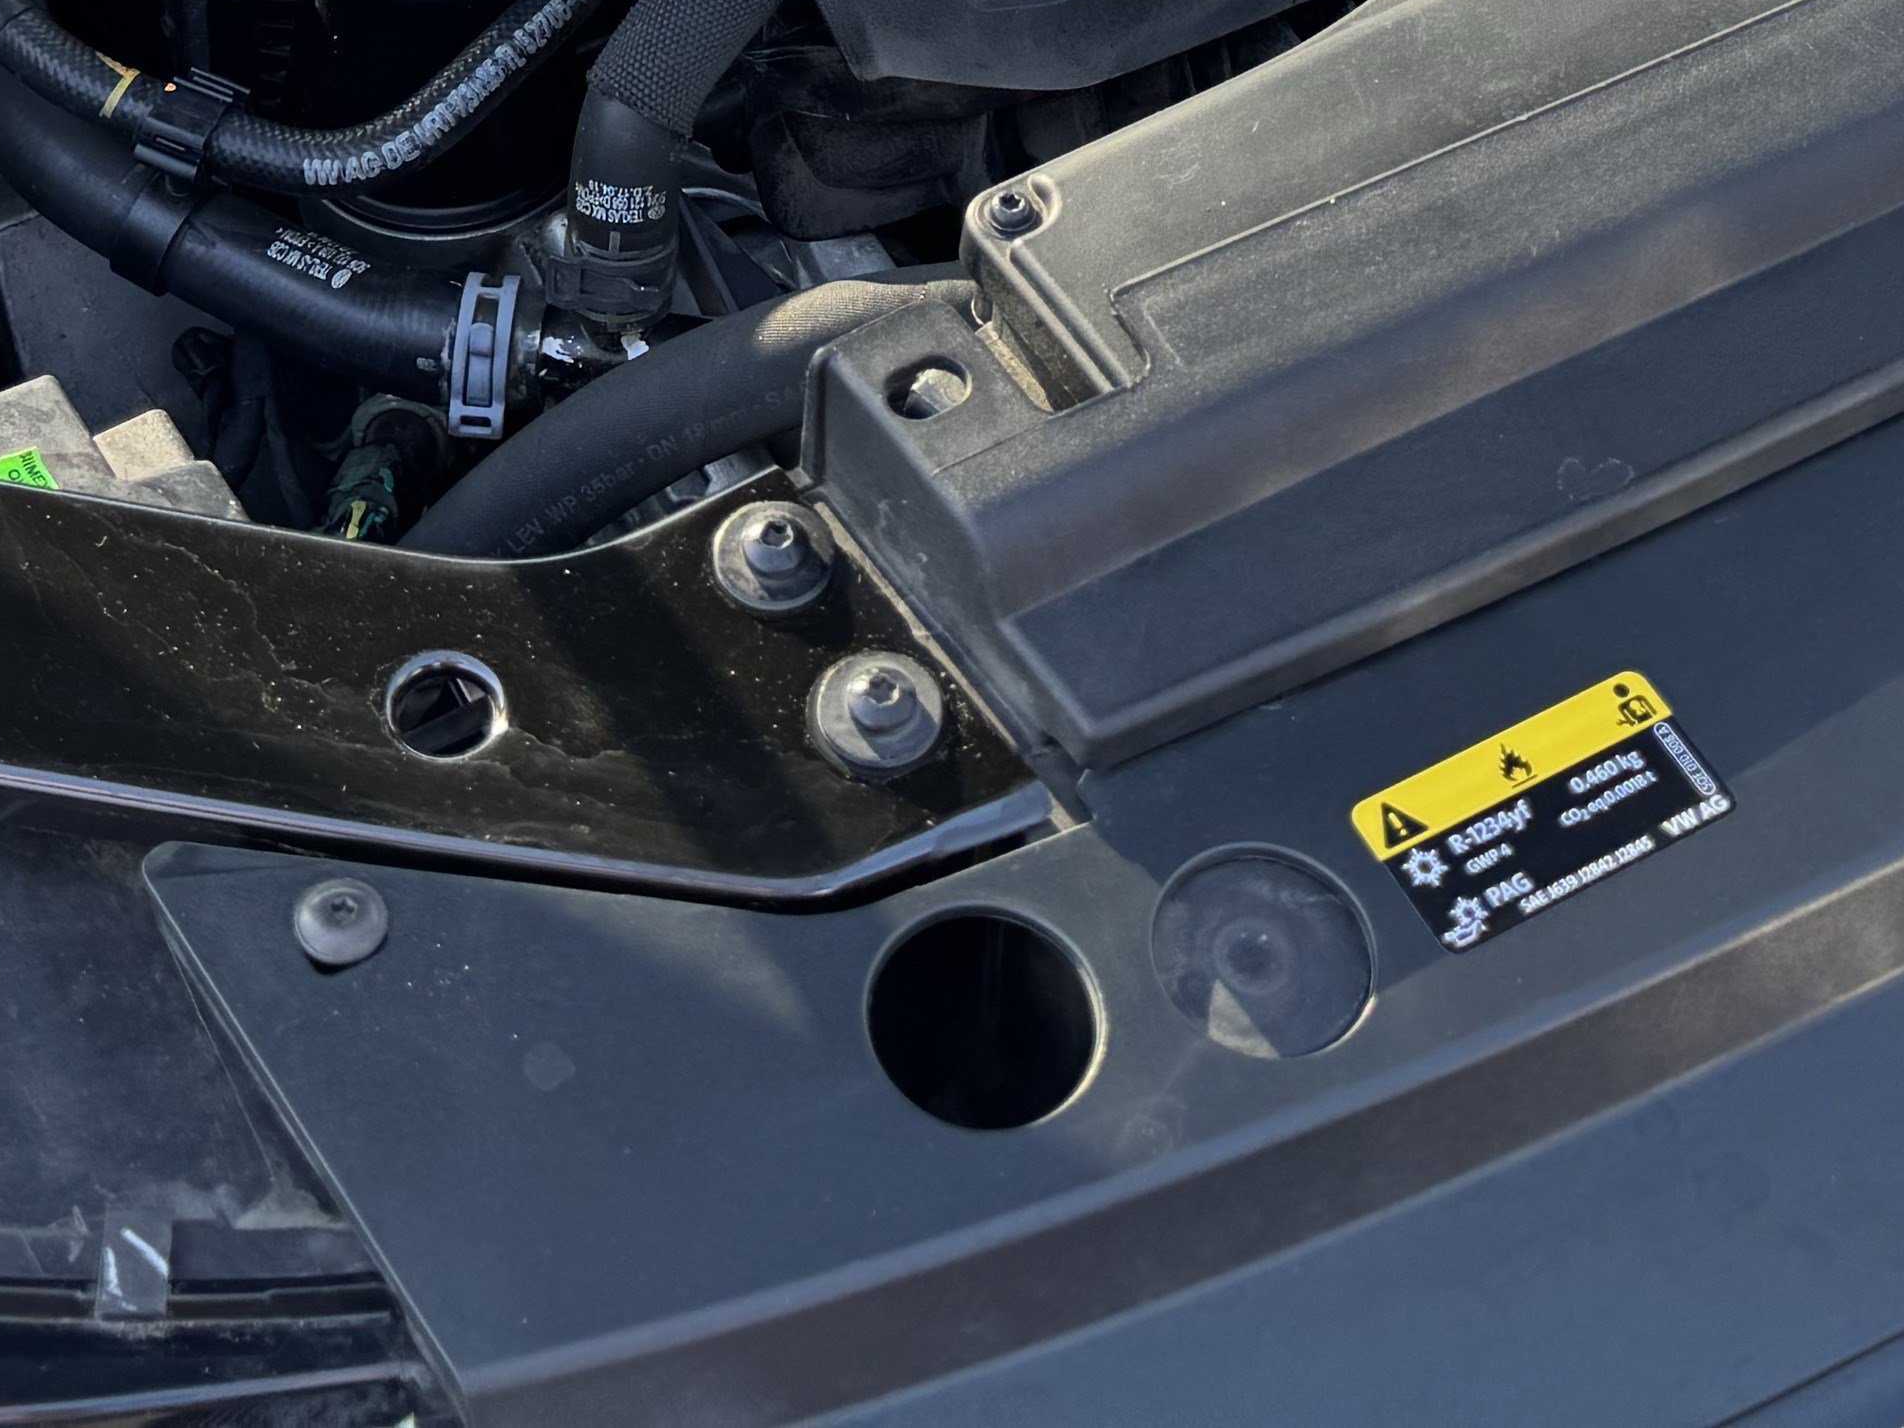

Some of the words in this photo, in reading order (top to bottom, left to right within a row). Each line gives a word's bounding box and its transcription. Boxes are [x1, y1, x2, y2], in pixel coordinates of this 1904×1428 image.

[1566, 758, 1621, 796] 0.460
[1614, 745, 1648, 775] kg
[1644, 768, 1659, 783] t
[1443, 796, 1540, 861] R-1234yf
[1658, 805, 1704, 839] VW
[1694, 790, 1735, 822] AG
[1462, 846, 1503, 876] GWP
[1497, 841, 1514, 858] 4
[1518, 889, 1551, 914] SAE
[1544, 872, 1583, 901] J639
[1575, 853, 1619, 884] J2842
[1612, 834, 1655, 864] J2845
[1481, 869, 1536, 909] PAG
